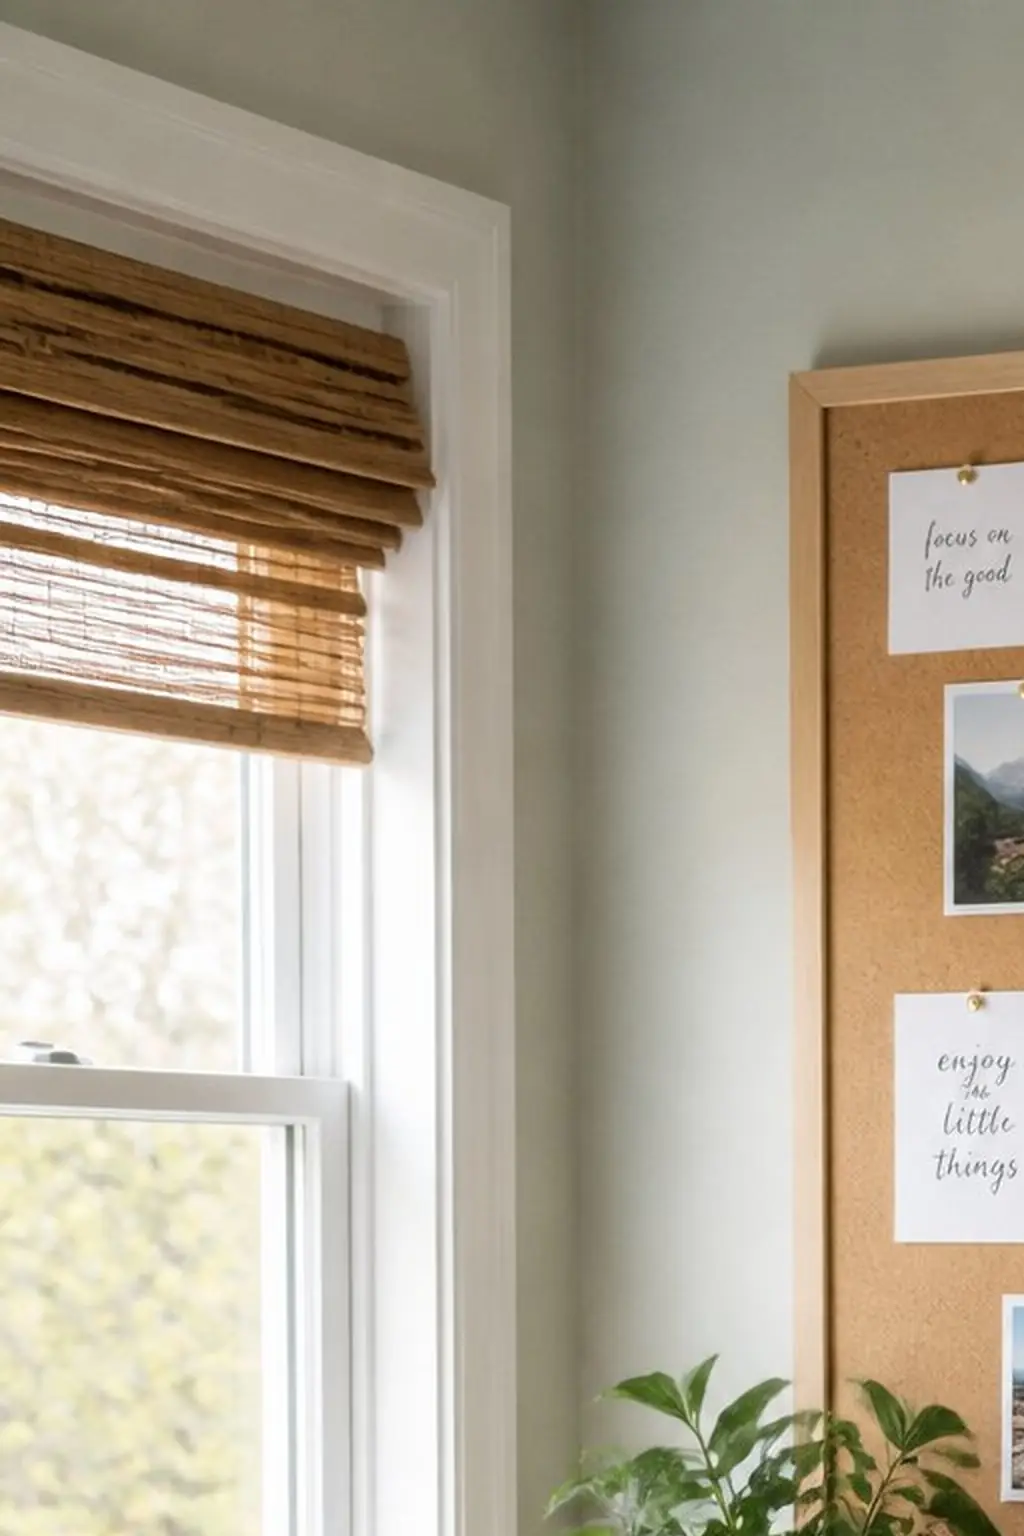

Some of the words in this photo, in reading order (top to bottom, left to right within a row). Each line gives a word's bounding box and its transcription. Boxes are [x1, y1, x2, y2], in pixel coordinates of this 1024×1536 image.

[925, 520, 977, 560] focus
[987, 529, 1012, 544] on
[925, 560, 955, 592] the
[962, 554, 1012, 599] good
[938, 1044, 1016, 1086] enjoy
[944, 1102, 1014, 1135] little
[932, 1147, 1018, 1195] things
